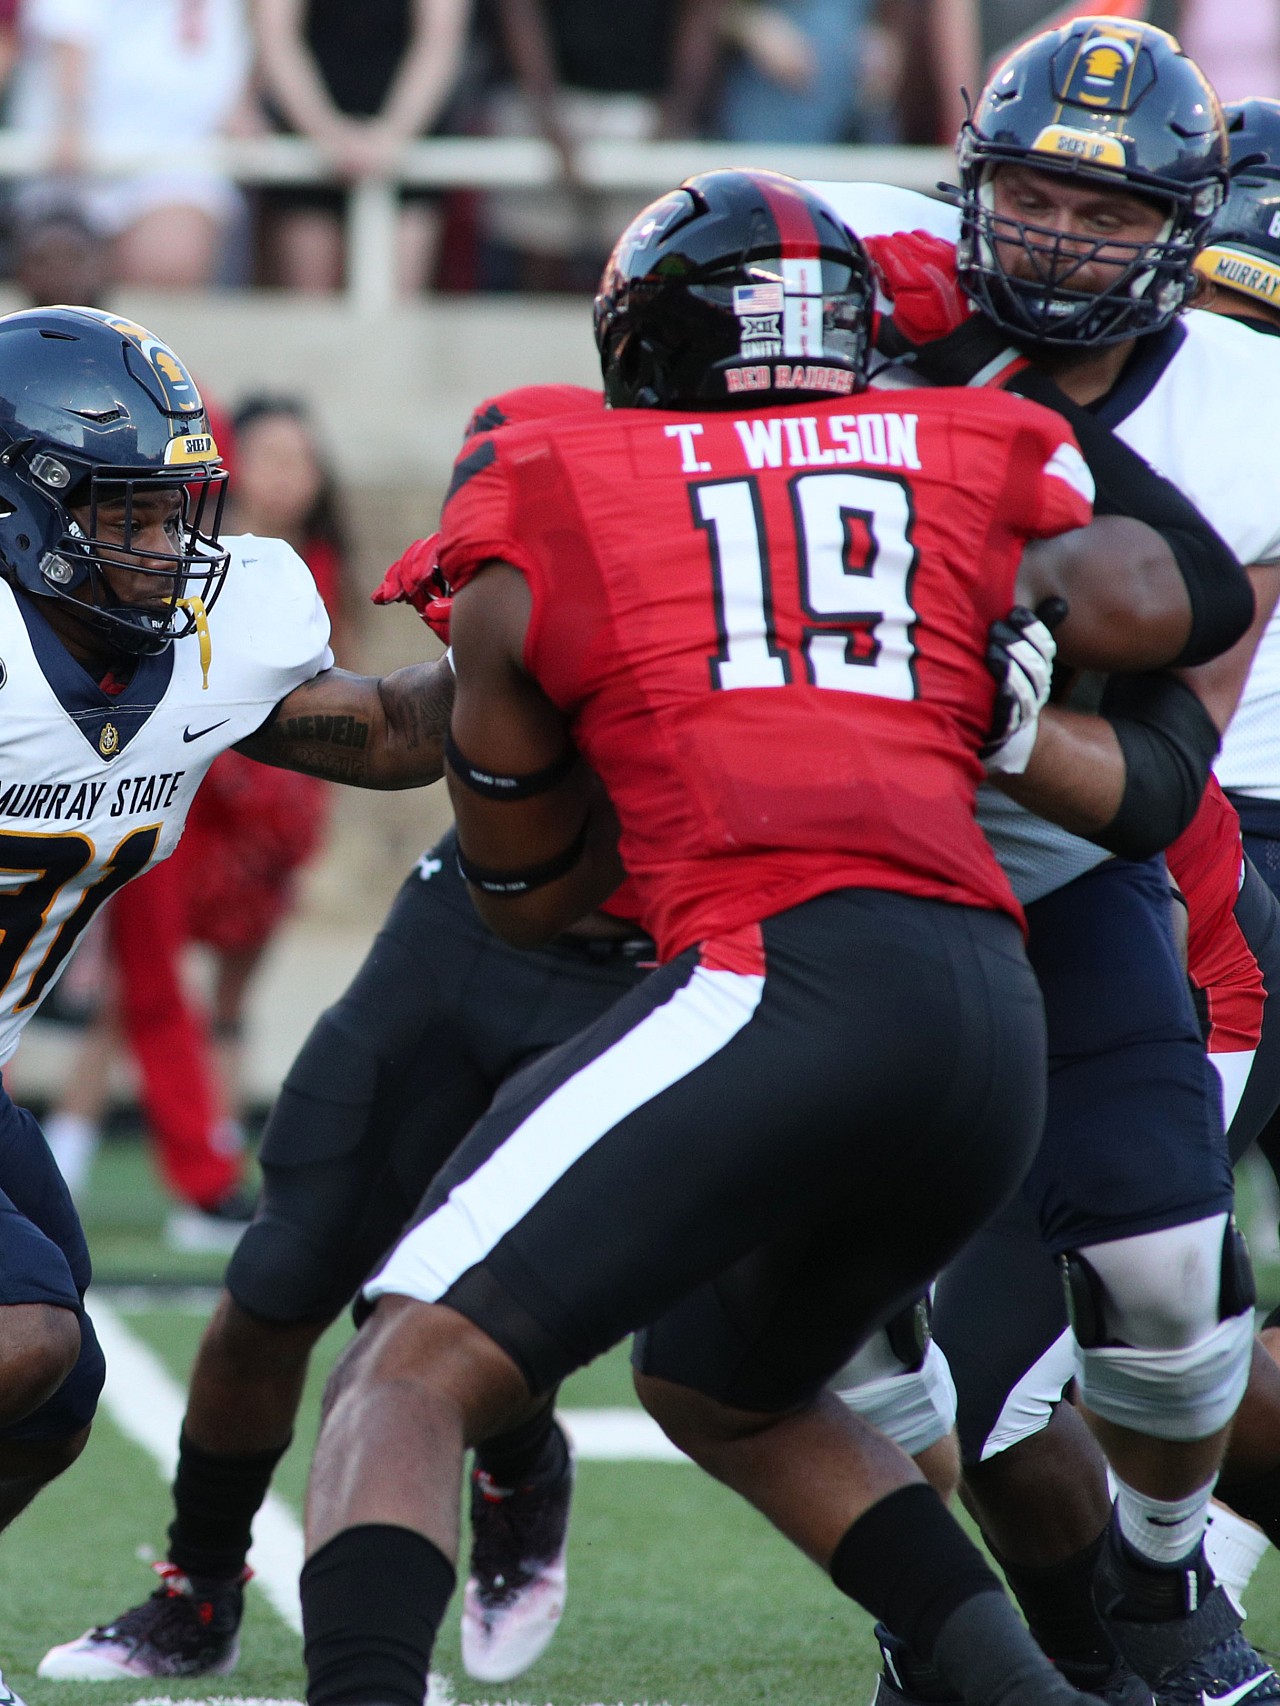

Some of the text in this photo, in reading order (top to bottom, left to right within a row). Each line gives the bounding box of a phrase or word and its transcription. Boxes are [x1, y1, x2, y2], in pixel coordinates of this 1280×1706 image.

[740, 340, 782, 359] UNITY
[725, 364, 856, 394] RED RAIDERS
[664, 413, 922, 473] T. WILSON
[687, 469, 919, 701] 19
[109, 770, 186, 818] STATE
